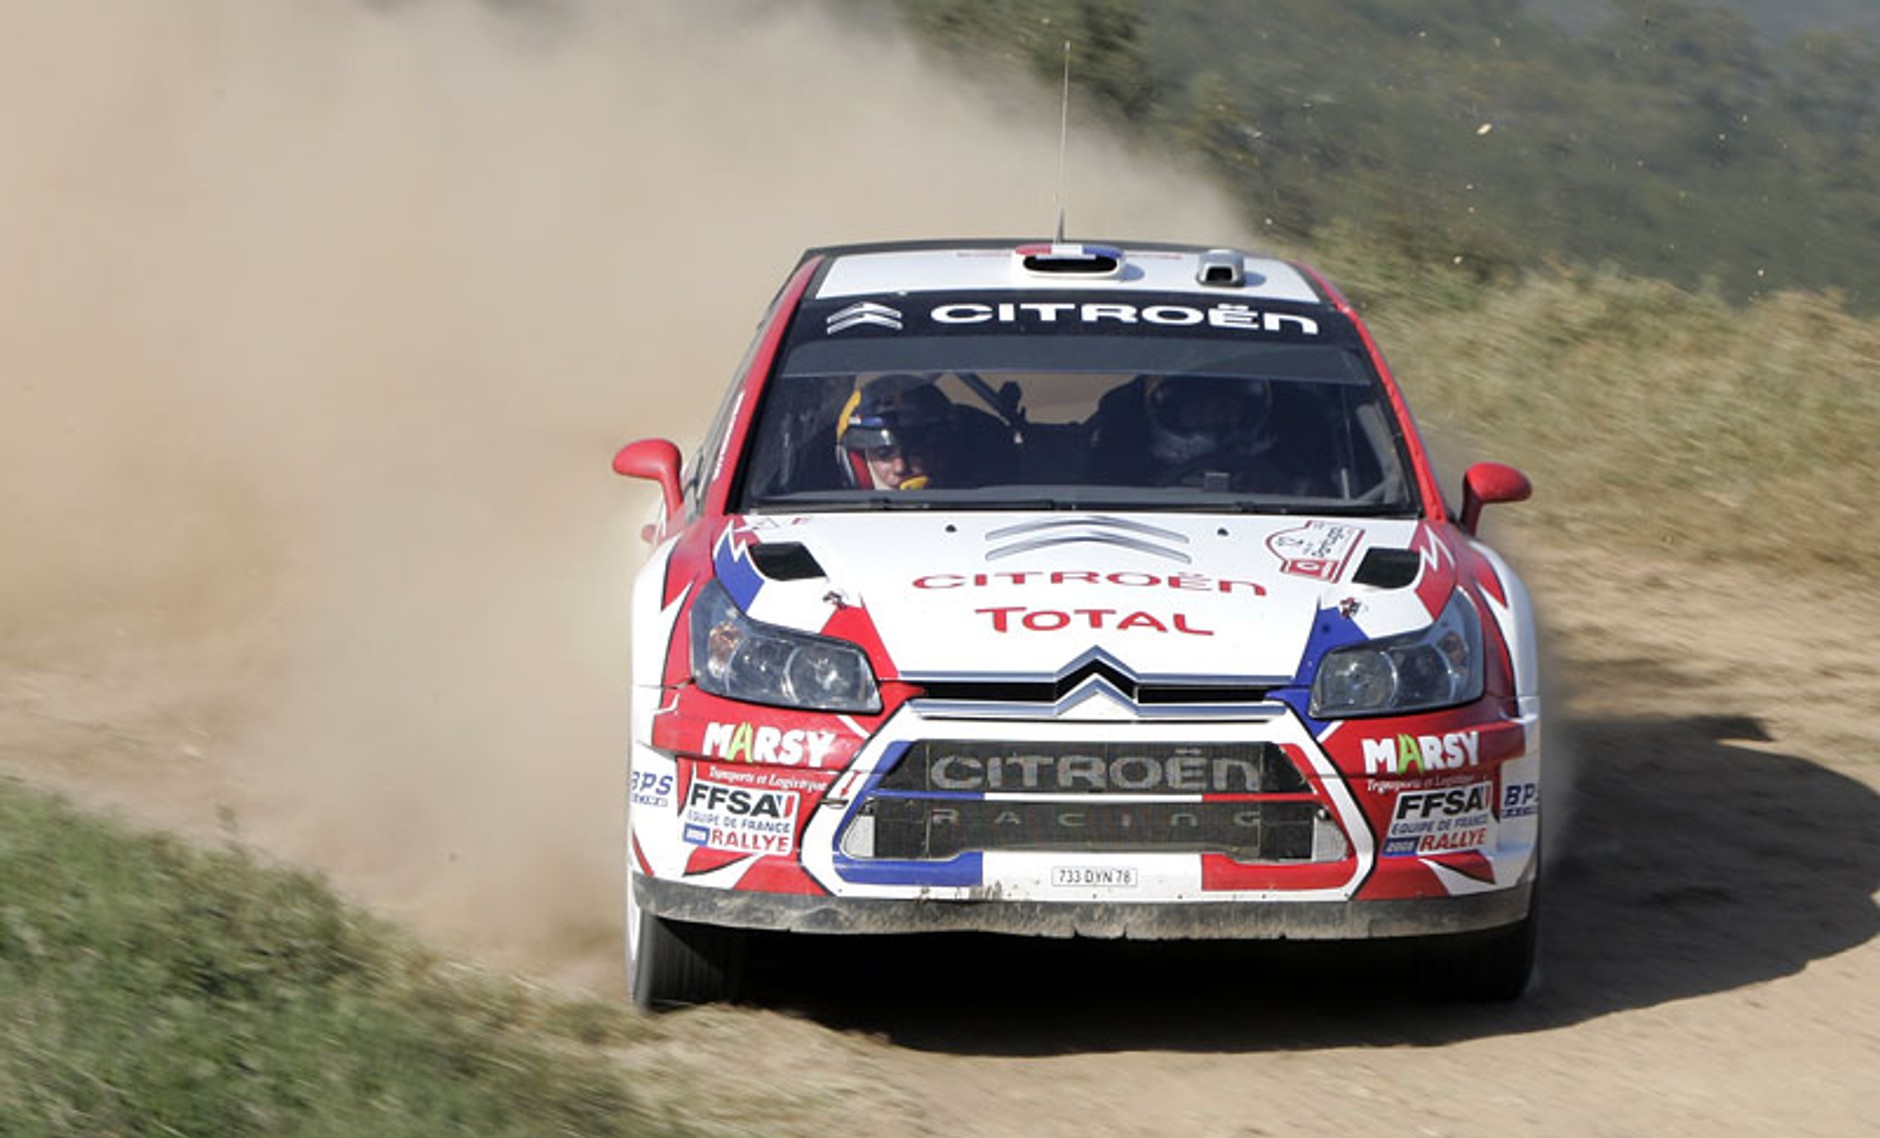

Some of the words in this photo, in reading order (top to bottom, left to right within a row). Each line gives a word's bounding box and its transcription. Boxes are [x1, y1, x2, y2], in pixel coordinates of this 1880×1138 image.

[974, 606, 1215, 635] TOTAL
[702, 721, 836, 767] MARSY
[1361, 730, 1480, 775] MARSY
[690, 783, 781, 819] FFSA
[1397, 786, 1483, 820] FFSA
[724, 816, 736, 828] DE
[740, 818, 791, 834] FRANCE
[1391, 818, 1434, 836] EQUIPE
[711, 828, 790, 853] RALLYE
[1419, 828, 1487, 852] RALLYE
[1059, 869, 1081, 884] 733
[1084, 869, 1113, 884] DYN
